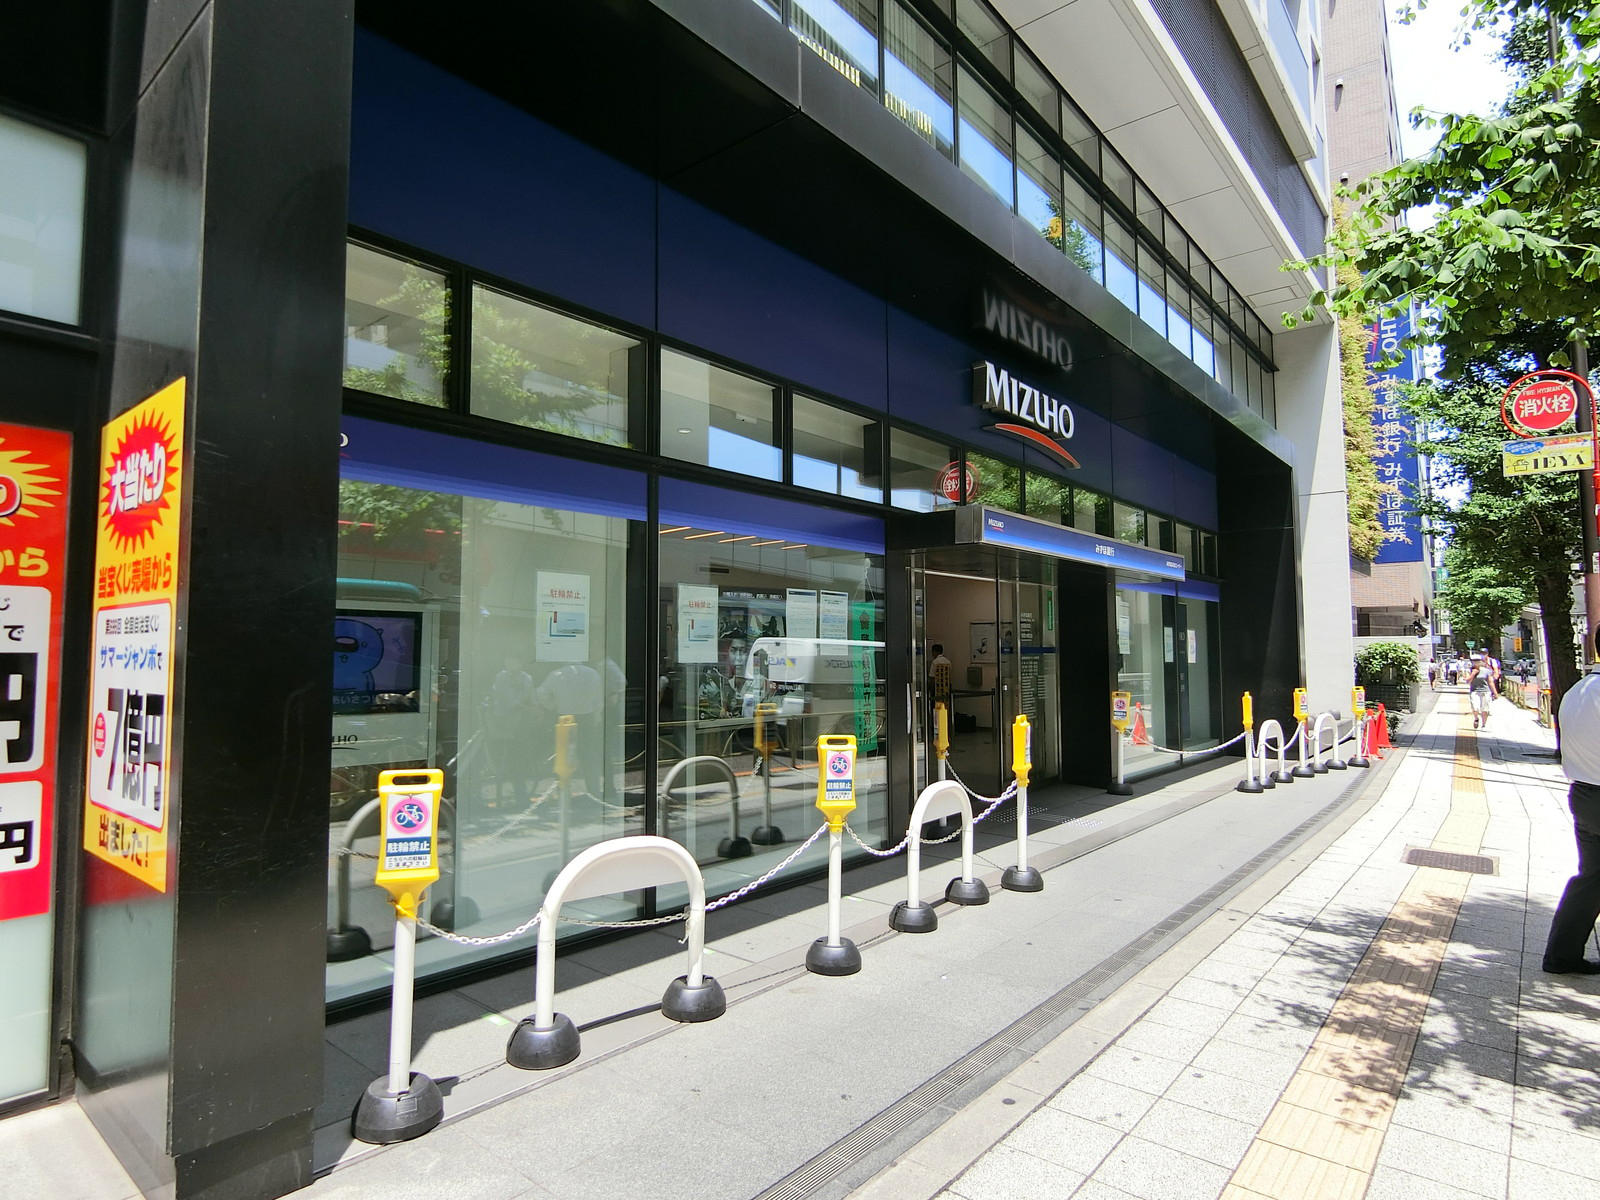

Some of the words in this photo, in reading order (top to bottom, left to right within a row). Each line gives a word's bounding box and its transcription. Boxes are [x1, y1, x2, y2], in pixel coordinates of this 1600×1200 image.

[985, 360, 1075, 439] MIZUHO
[1537, 386, 1563, 394] HYDRANT
[1519, 393, 1571, 418] 消火栓
[1533, 453, 1585, 470] IEYA
[110, 442, 167, 516] 大当たり
[98, 552, 172, 599] 当宝くじ売場から
[550, 588, 581, 599] 駐輪禁止
[3, 624, 25, 641] で
[100, 643, 163, 671] サマージャンボで
[107, 687, 165, 812] 7億円
[0, 821, 34, 865] 円
[387, 840, 431, 853] 駐輪禁止
